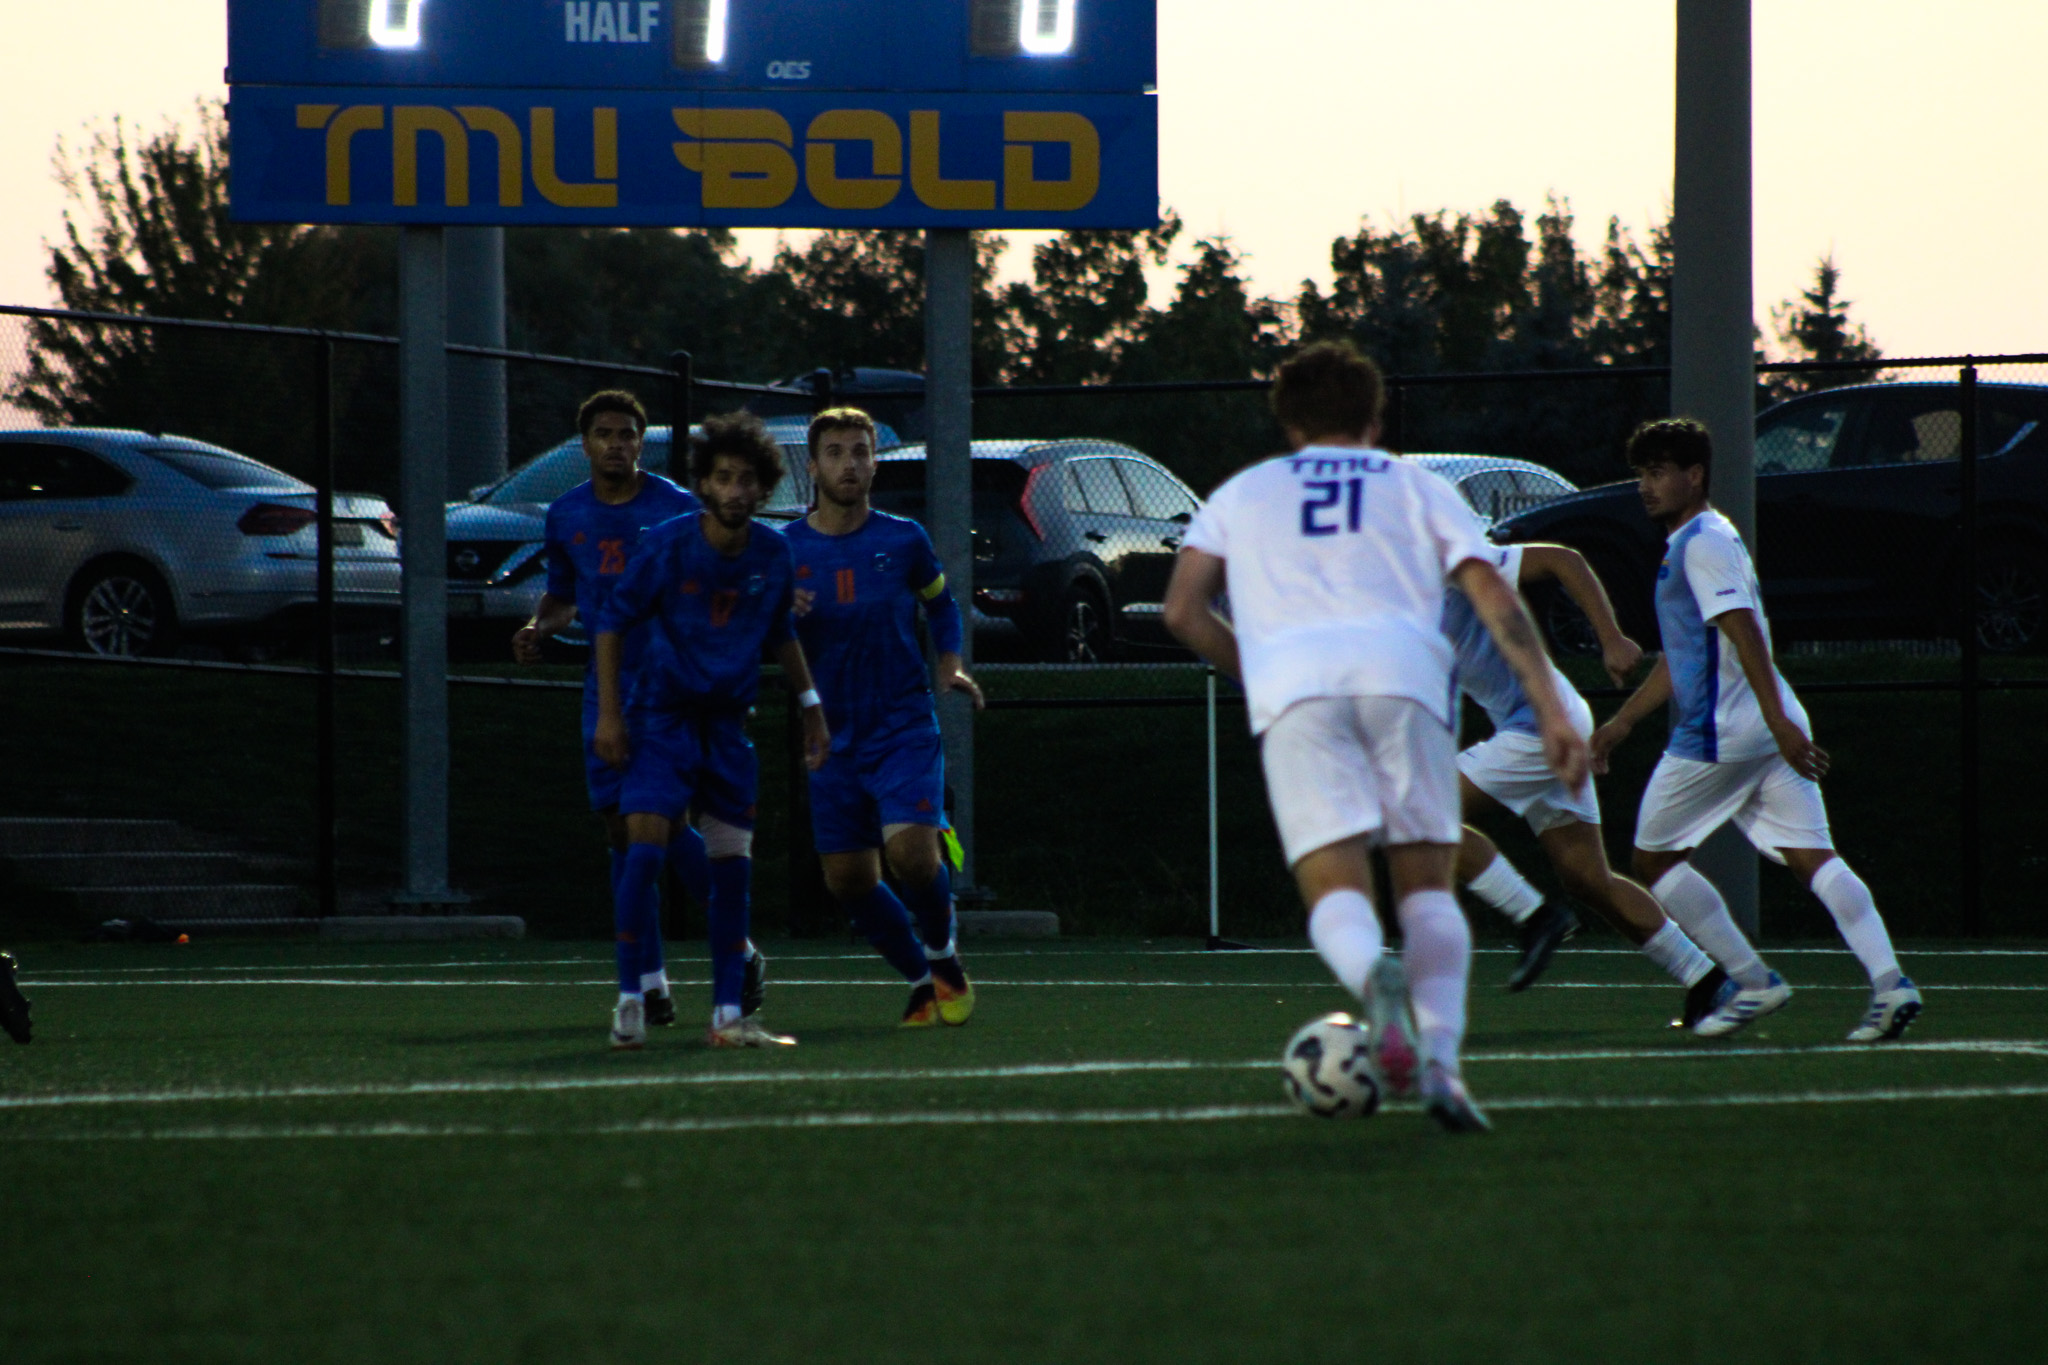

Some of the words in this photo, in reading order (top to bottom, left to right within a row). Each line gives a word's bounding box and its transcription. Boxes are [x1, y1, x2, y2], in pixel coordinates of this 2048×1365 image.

[565, 2, 660, 43] HALF
[296, 104, 619, 207] TMU
[671, 107, 1101, 211] BOLD
[1301, 478, 1363, 537] 21
[597, 538, 626, 575] 25
[834, 567, 856, 605] 11
